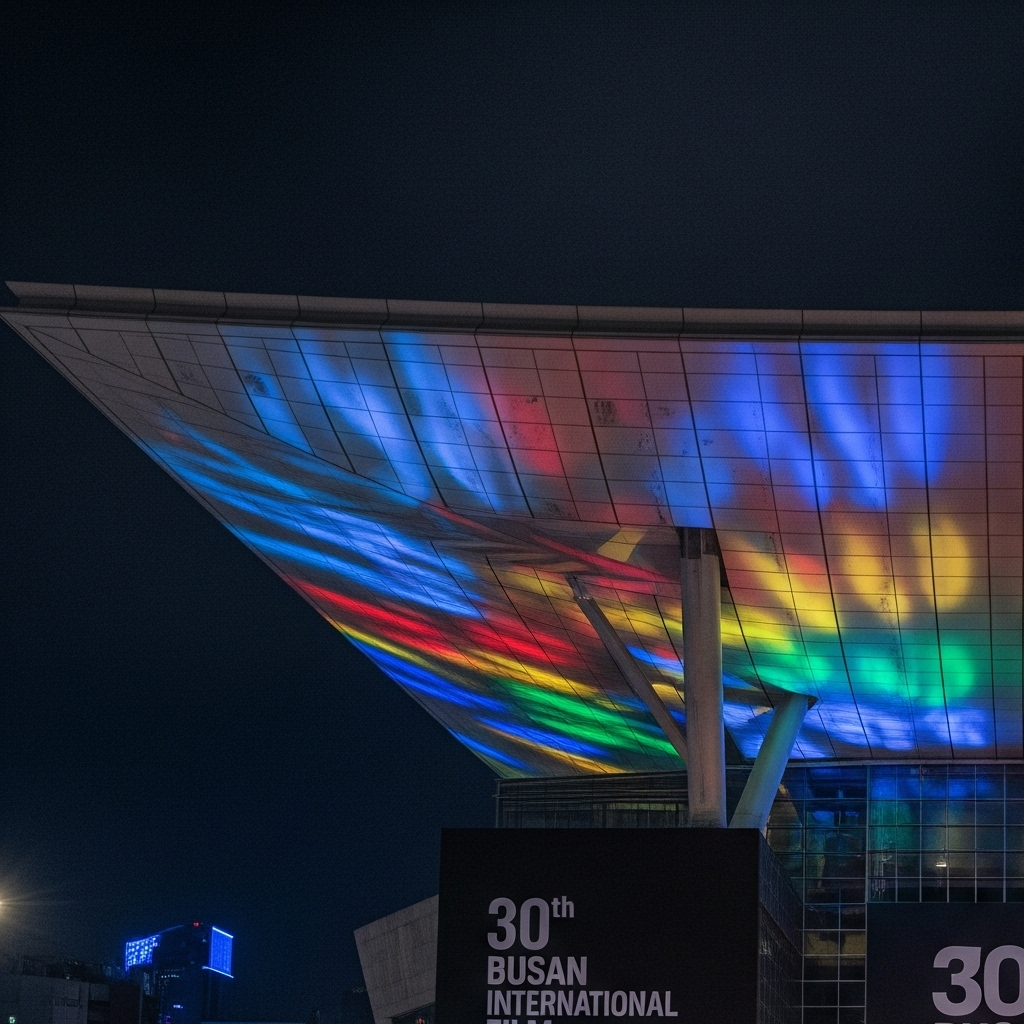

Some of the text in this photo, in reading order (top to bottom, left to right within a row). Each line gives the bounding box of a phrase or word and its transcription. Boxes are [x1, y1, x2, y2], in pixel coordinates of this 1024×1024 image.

[487, 896, 575, 950] 30th
[487, 956, 588, 986] BUSAN
[486, 990, 679, 1017] INTERNATIONAL
